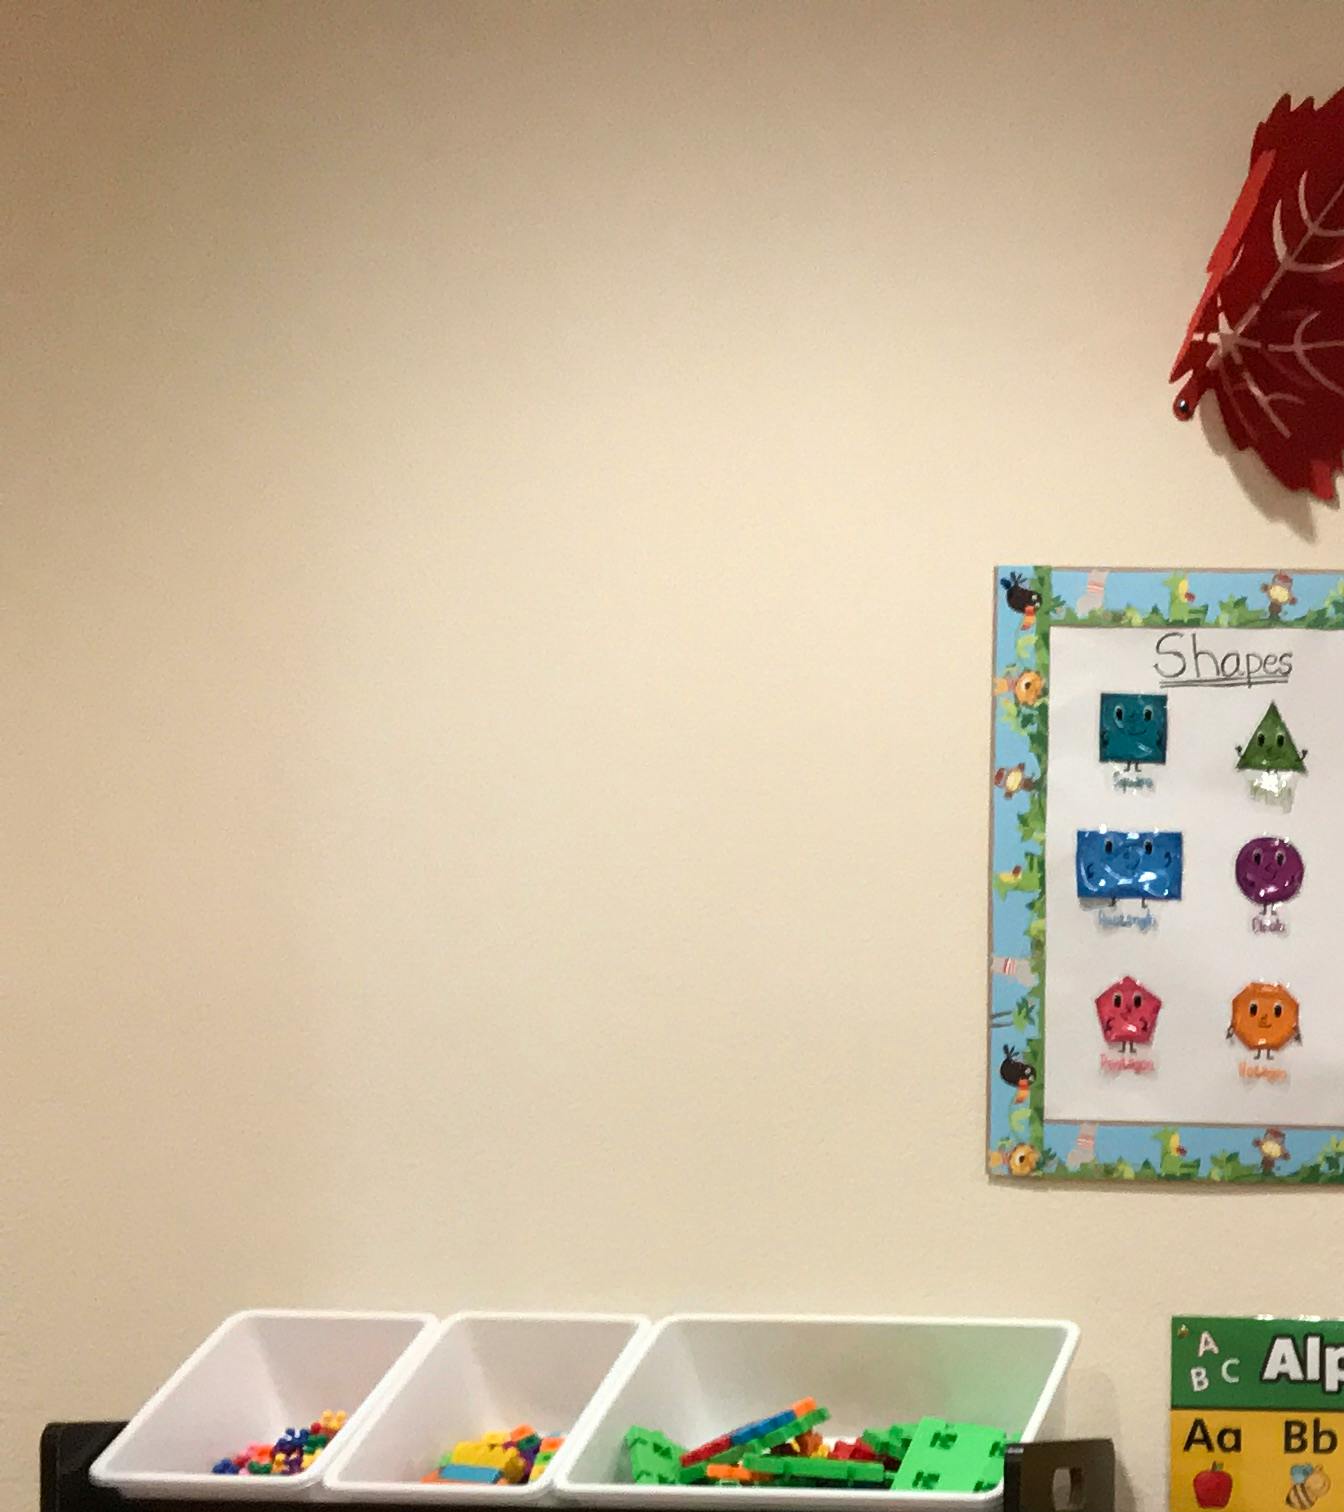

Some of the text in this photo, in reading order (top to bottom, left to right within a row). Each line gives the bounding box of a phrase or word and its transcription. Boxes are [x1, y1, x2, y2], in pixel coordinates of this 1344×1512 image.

[1154, 631, 1294, 687] Shapes
[1183, 1418, 1242, 1454] Aa
[1283, 1418, 1338, 1455] Bb
